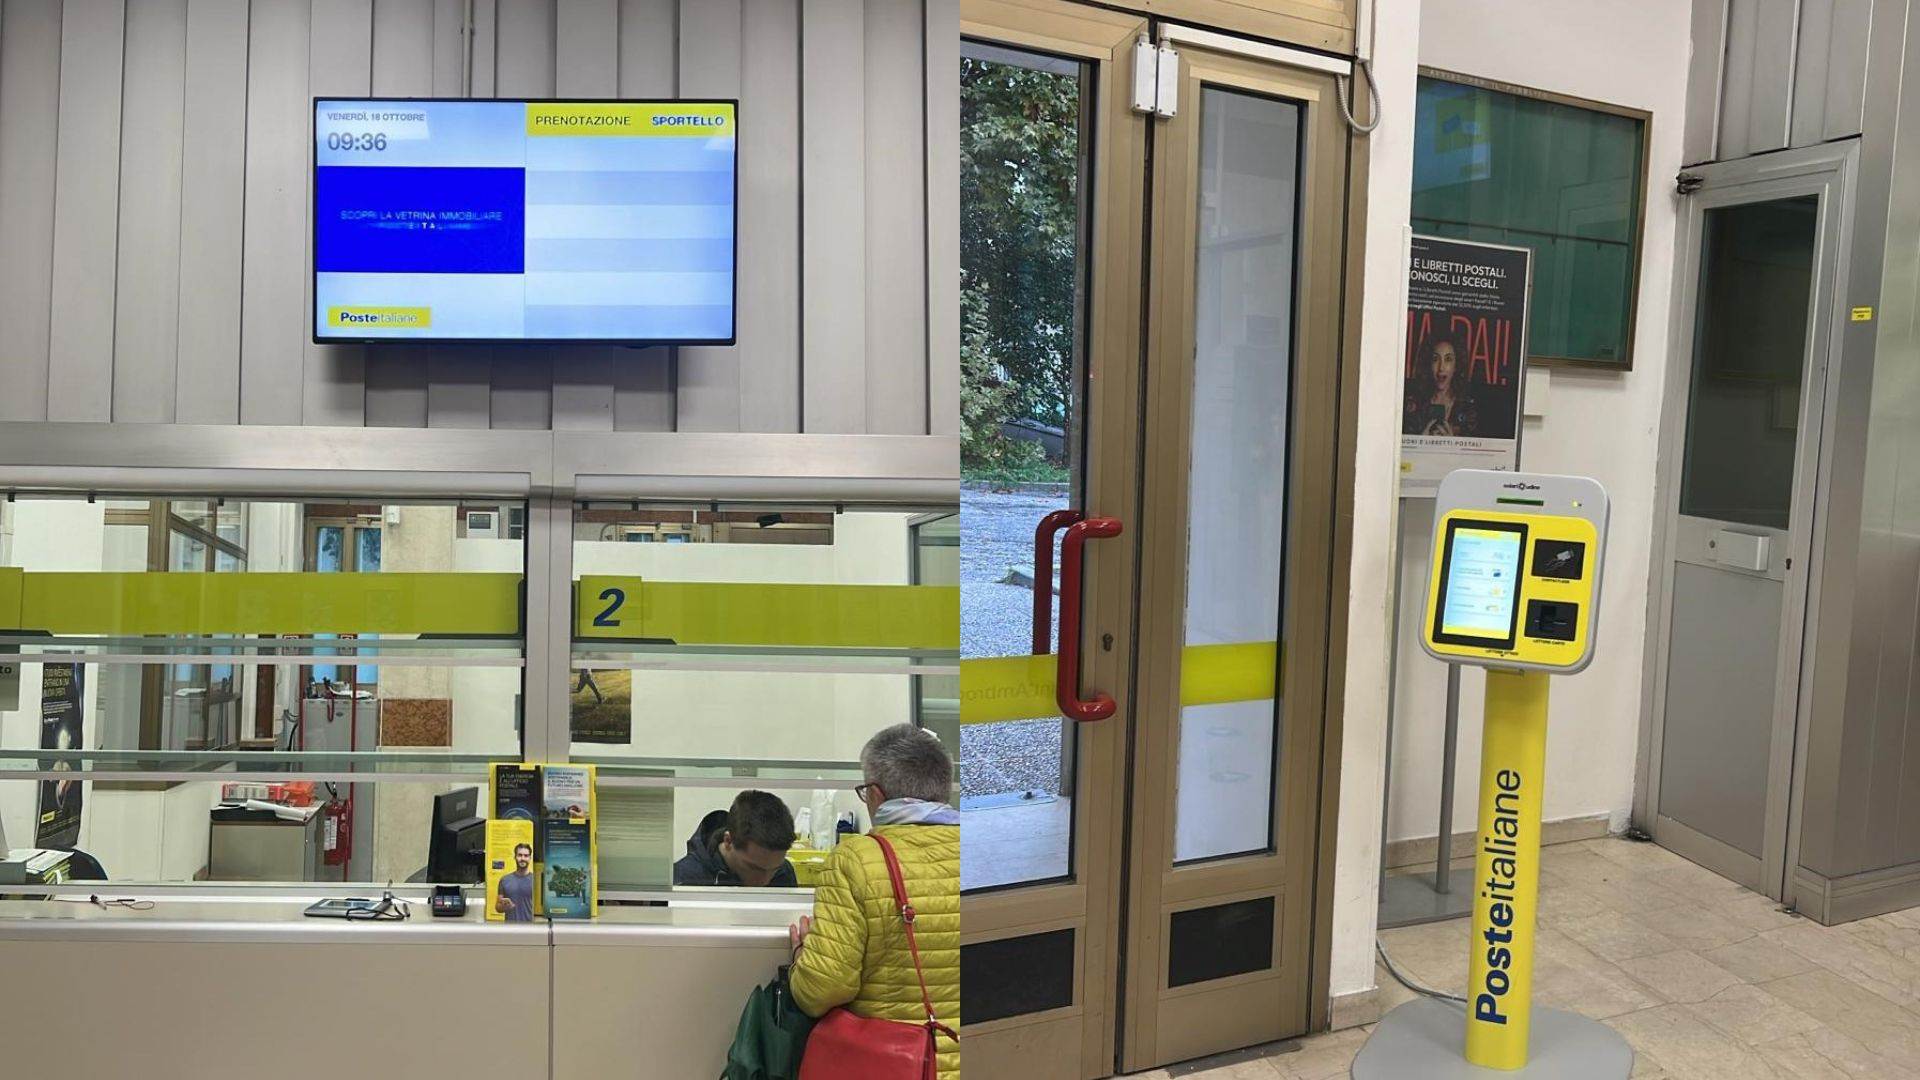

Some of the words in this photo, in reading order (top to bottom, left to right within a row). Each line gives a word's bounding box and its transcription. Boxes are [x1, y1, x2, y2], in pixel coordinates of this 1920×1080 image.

[371, 113, 381, 121] 18
[382, 113, 425, 121] OTTOBRE
[535, 116, 631, 126] PRENOTAZIONE
[652, 116, 725, 126] SPORTELLO
[327, 132, 387, 151] 09:36
[340, 210, 377, 220] SCOPRI
[380, 211, 392, 220] LA
[394, 211, 436, 221] VETRINA
[439, 211, 503, 221] IMMOBILIARE
[1413, 258, 1421, 269] E
[1421, 259, 1464, 274] LIBRETTI
[1464, 265, 1507, 279] POSTALI.
[1409, 270, 1450, 286] ONOSCI,
[1451, 275, 1461, 286] LI
[1461, 276, 1499, 290] SCEGLI.
[340, 312, 418, 323] Posteitaliane
[592, 588, 625, 627] 2
[1475, 769, 1521, 1026] Posteitaliane
